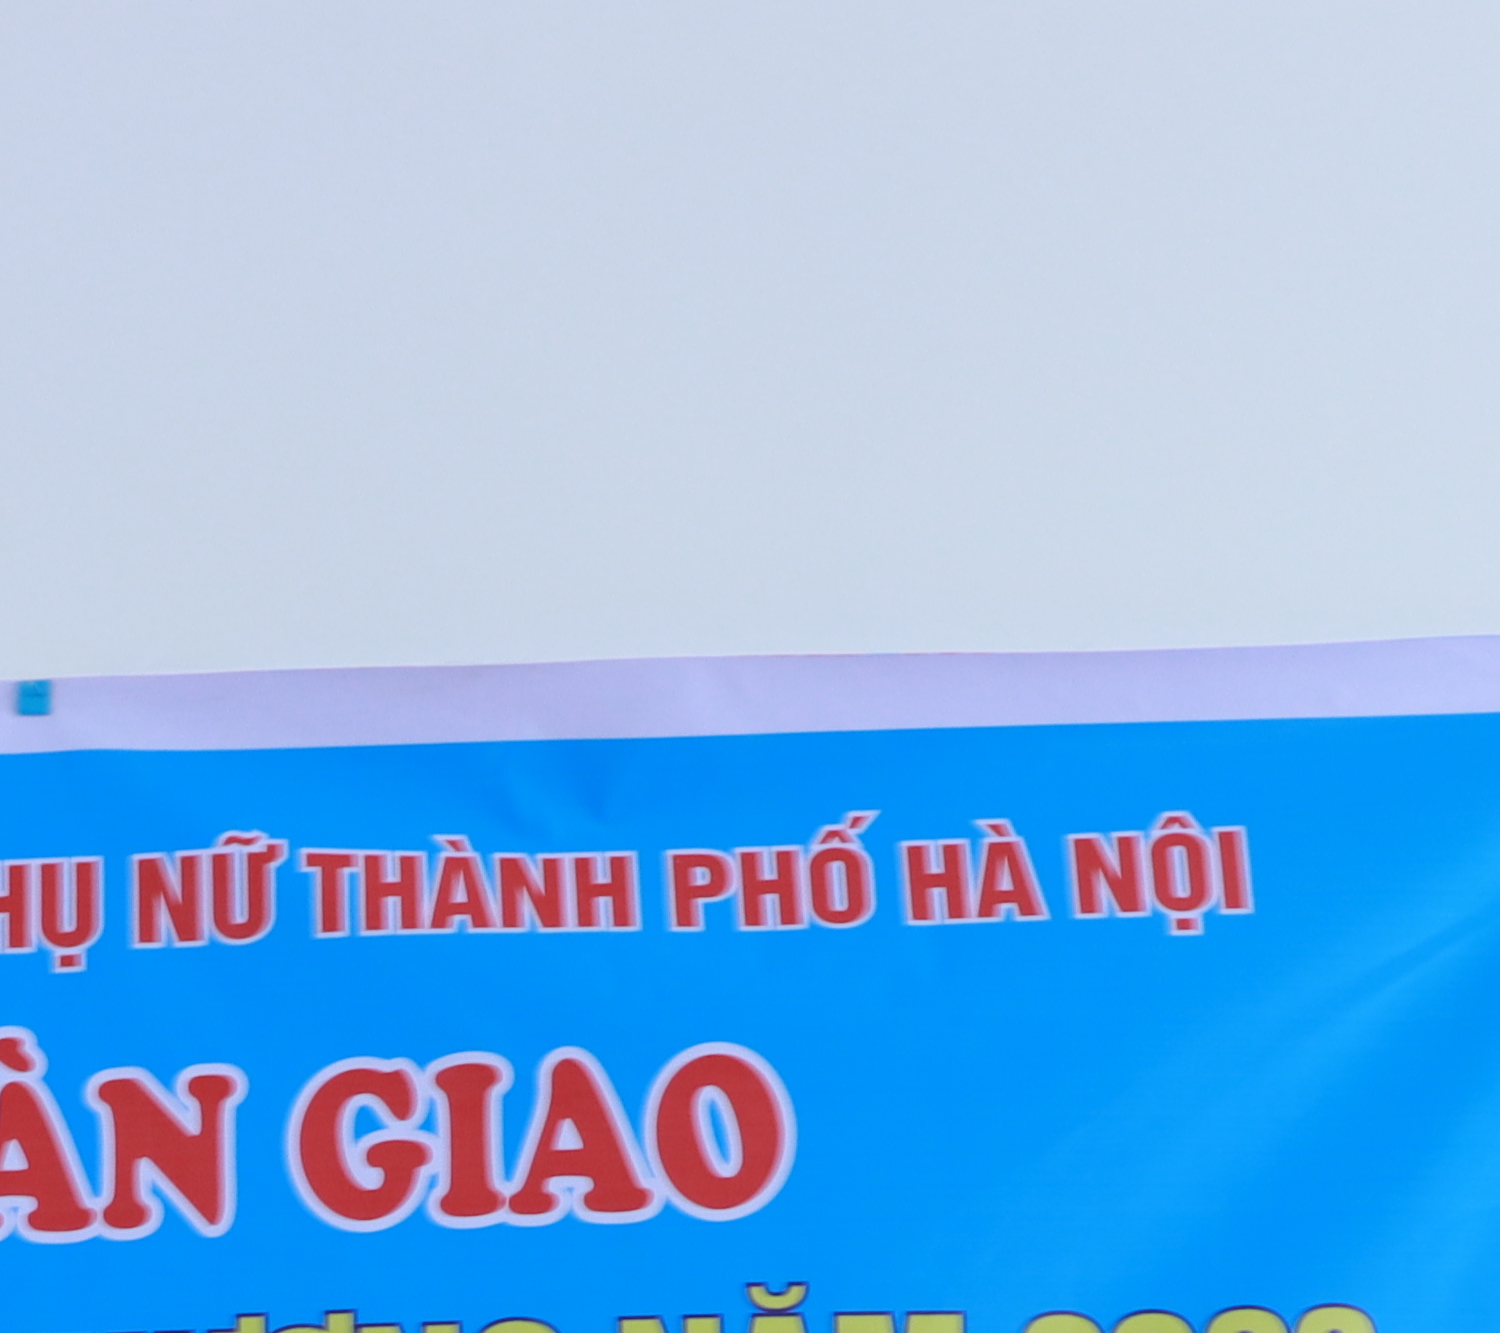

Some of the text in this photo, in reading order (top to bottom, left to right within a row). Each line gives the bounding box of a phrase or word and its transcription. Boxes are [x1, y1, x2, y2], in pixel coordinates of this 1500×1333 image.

[132, 831, 288, 947] NỮ
[304, 836, 639, 937] THÀNH
[667, 811, 879, 931] PHỐ
[902, 817, 1046, 926] HÀ
[1070, 811, 1253, 936] NỘI
[288, 1040, 796, 1232] GIAO
